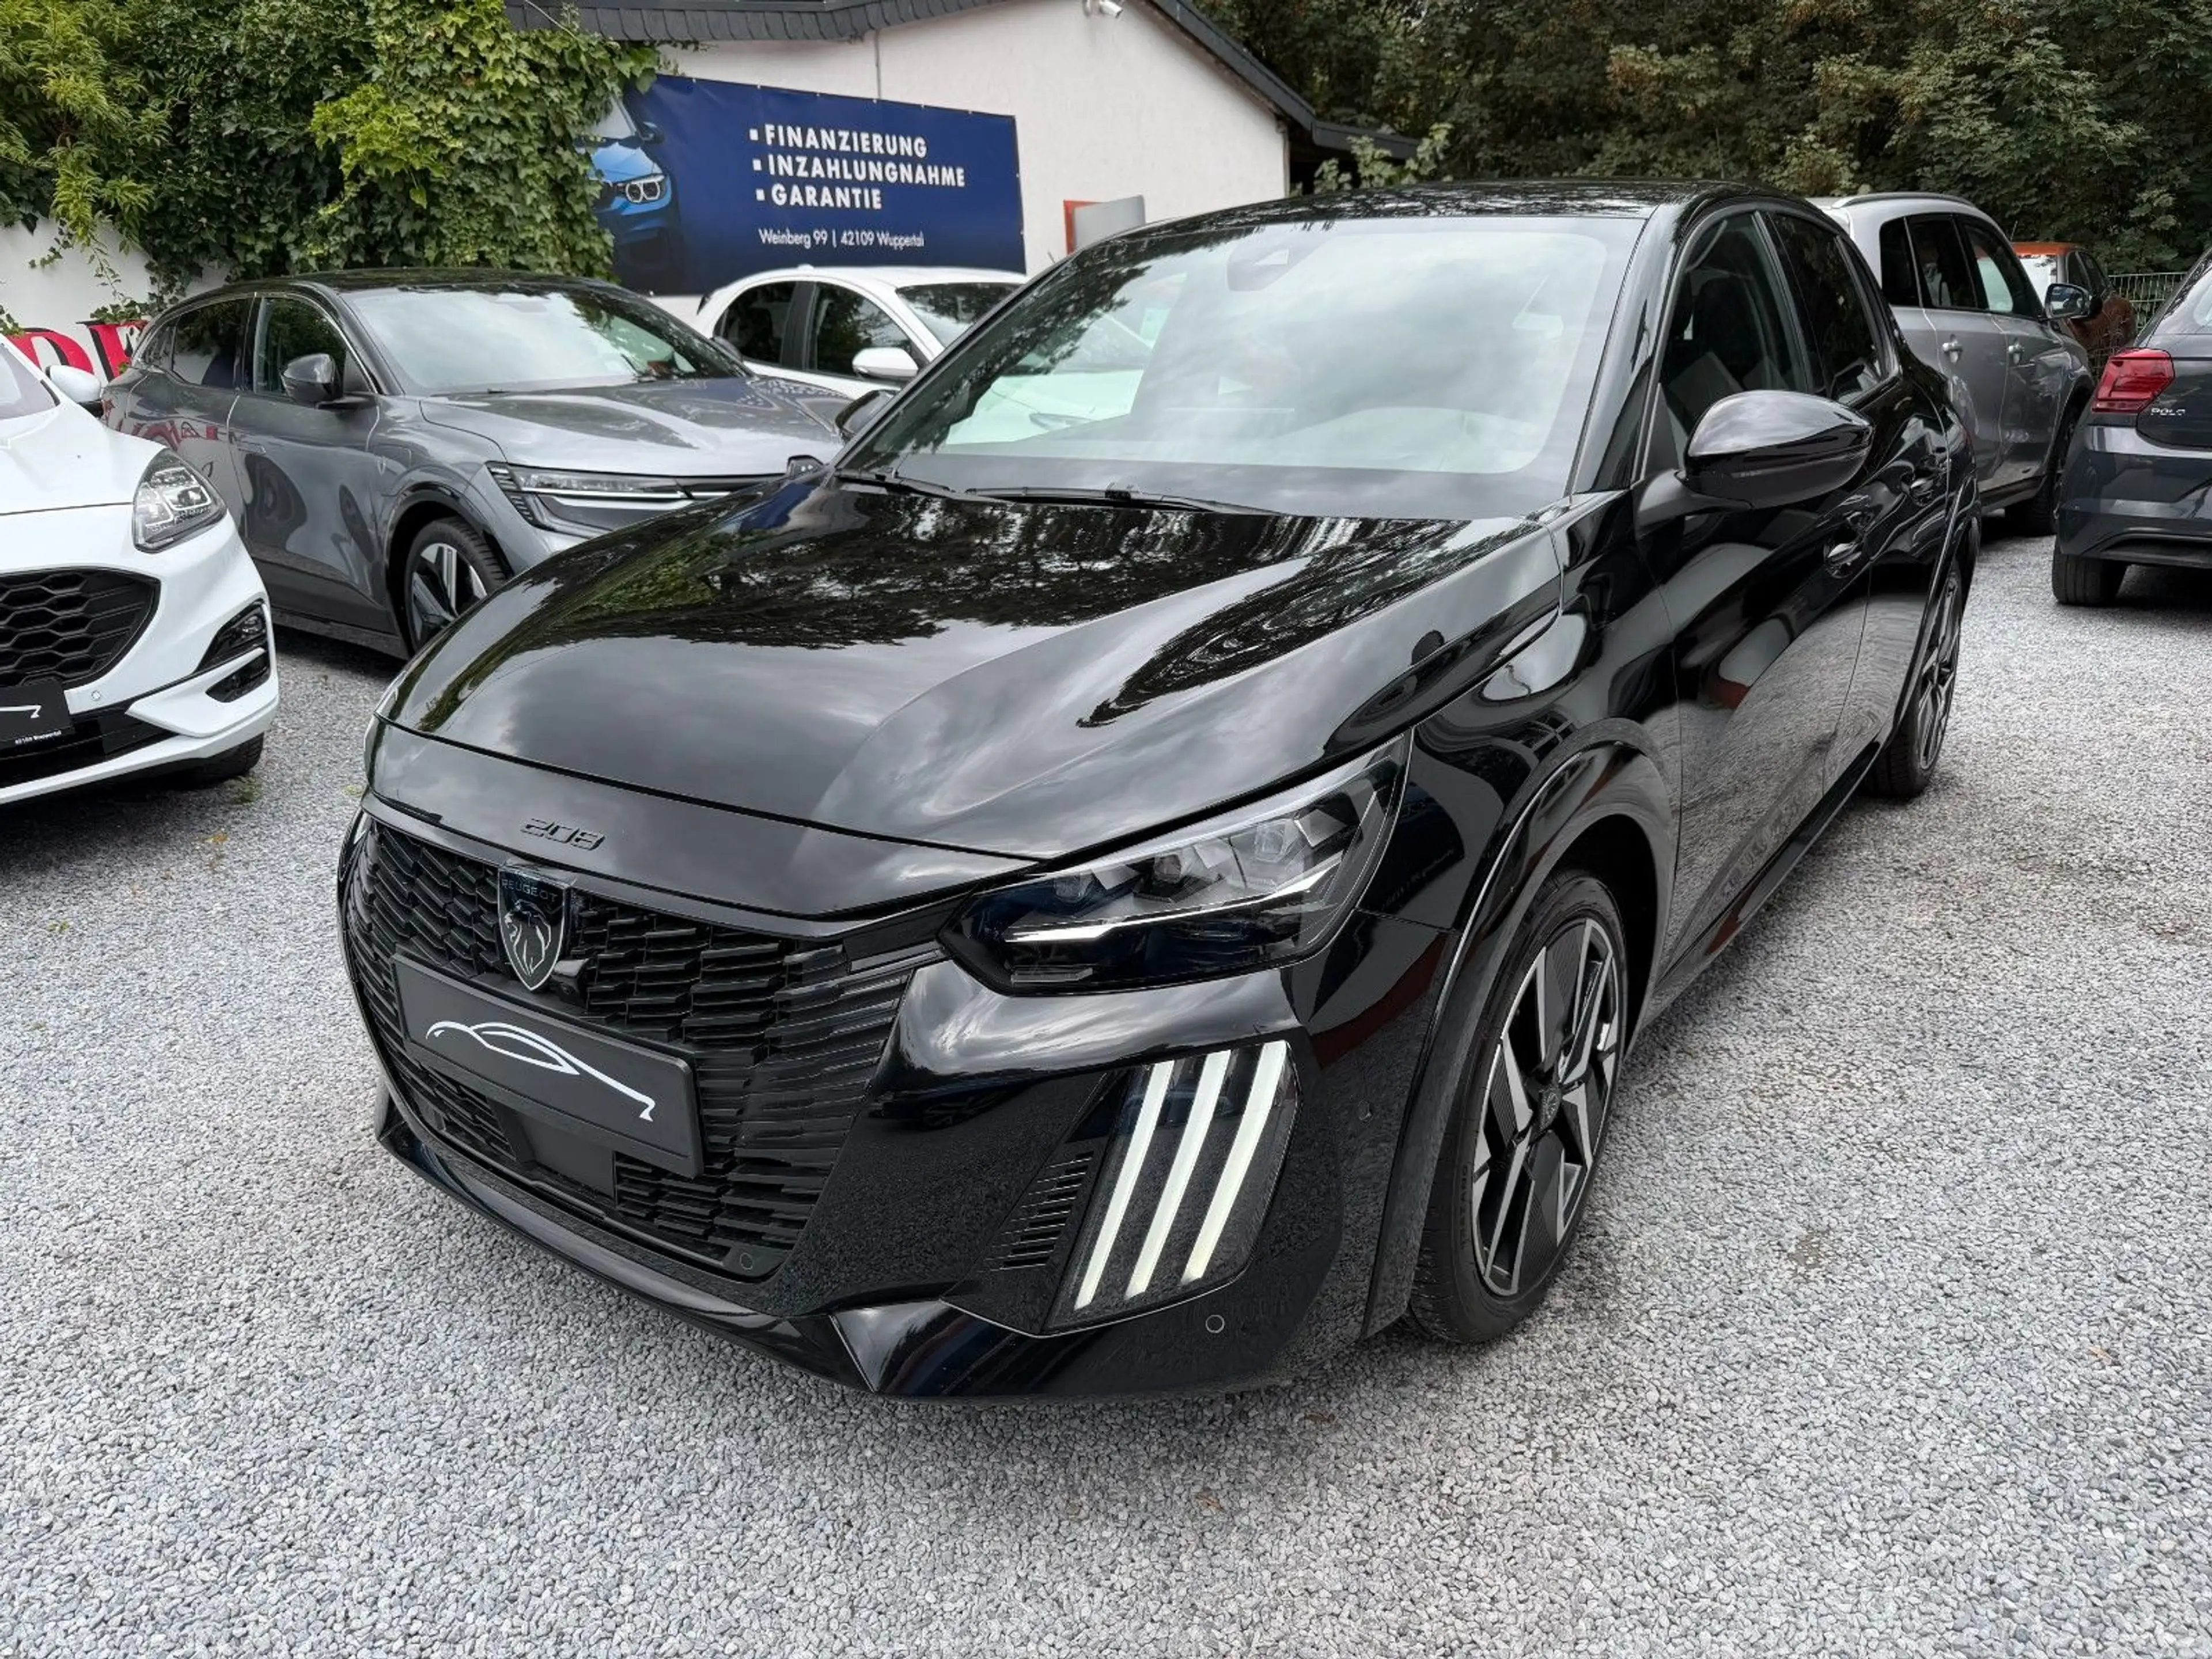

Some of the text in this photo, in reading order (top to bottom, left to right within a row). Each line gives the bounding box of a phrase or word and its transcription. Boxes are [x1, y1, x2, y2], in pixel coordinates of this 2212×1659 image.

[764, 124, 928, 159] FINANZIERUNG
[768, 154, 965, 187] INZAHLUNGNAHME
[771, 183, 882, 210] GARANTIE
[758, 228, 811, 249] Weinberg
[812, 230, 828, 246] 99
[840, 230, 875, 246] 42109
[876, 230, 925, 251] Wuppertal
[2150, 407, 2186, 416] POLO
[520, 817, 607, 851] 208
[501, 878, 558, 903] PEUGEOT
